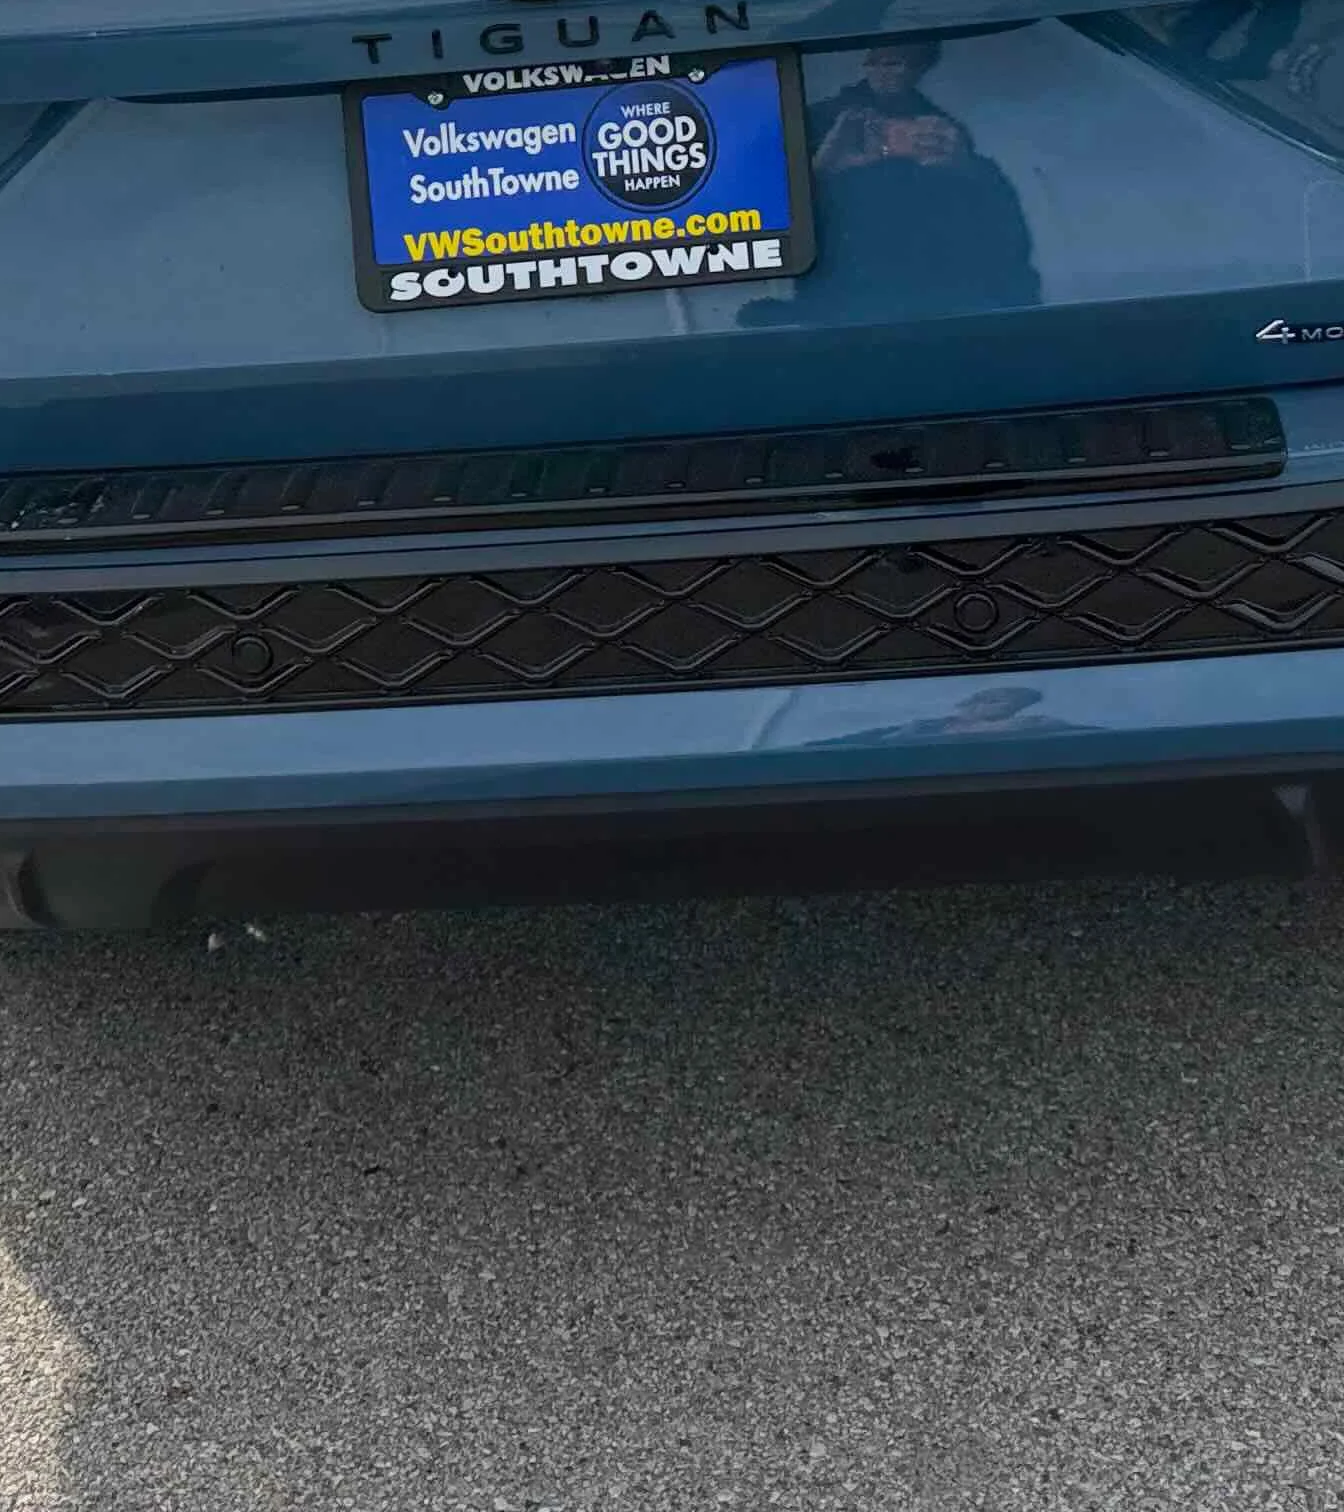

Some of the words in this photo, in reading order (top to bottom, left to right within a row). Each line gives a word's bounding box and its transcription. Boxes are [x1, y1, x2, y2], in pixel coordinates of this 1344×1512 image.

[352, 0, 750, 64] TIGUAN
[462, 55, 671, 94] VOLKSWEN
[621, 101, 671, 118] WHERE
[403, 122, 576, 158] Volkswagen
[598, 115, 697, 150] GOOD
[592, 142, 707, 178] THINGS
[410, 166, 580, 204] SouthTowne
[624, 174, 681, 192] HAPPEN
[403, 208, 761, 262] VWSouthtowne.com
[389, 239, 782, 301] SOUTHTOWNE
